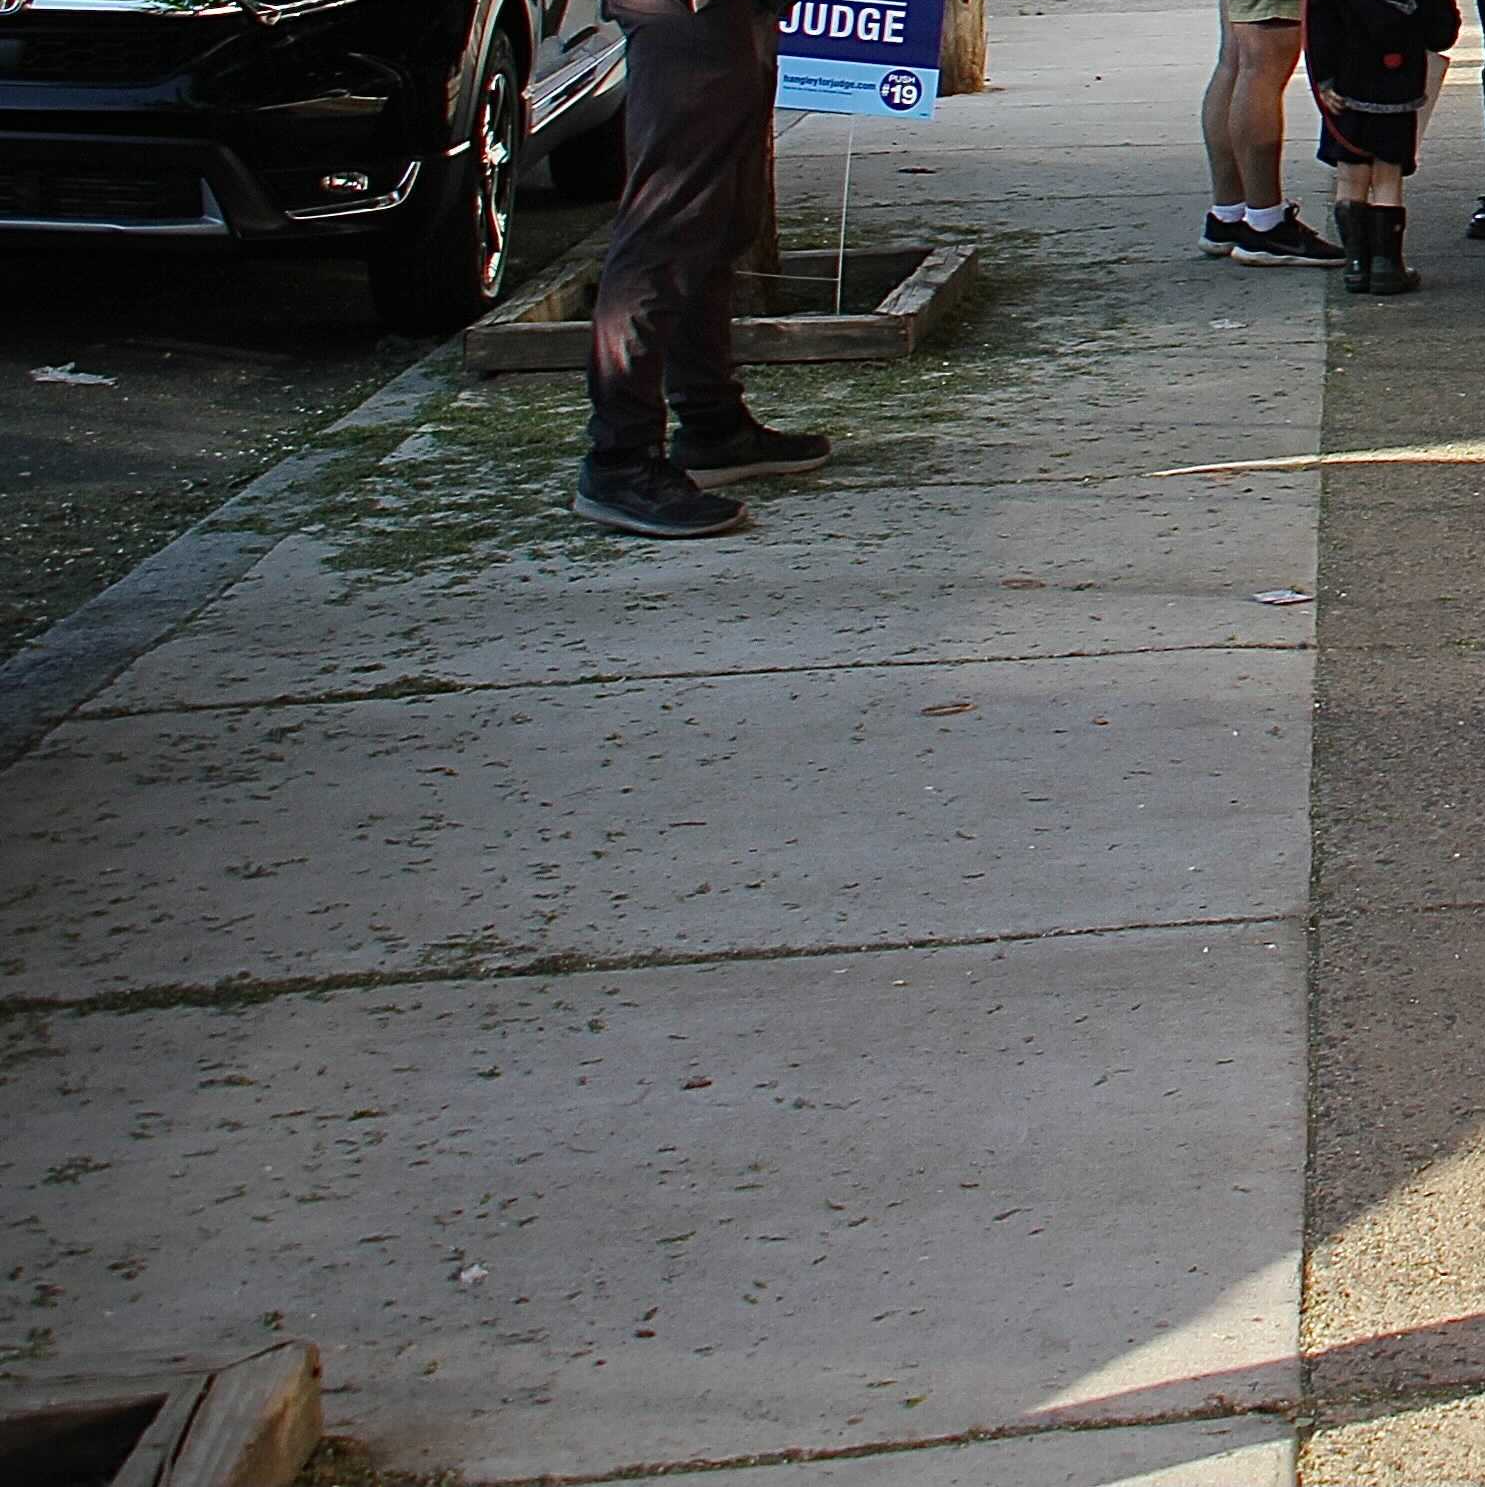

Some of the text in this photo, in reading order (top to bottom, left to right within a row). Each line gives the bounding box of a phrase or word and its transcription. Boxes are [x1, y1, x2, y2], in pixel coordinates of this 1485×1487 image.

[778, 0, 907, 44] JUDGE
[888, 73, 916, 85] PUSH
[880, 82, 918, 105] #19
